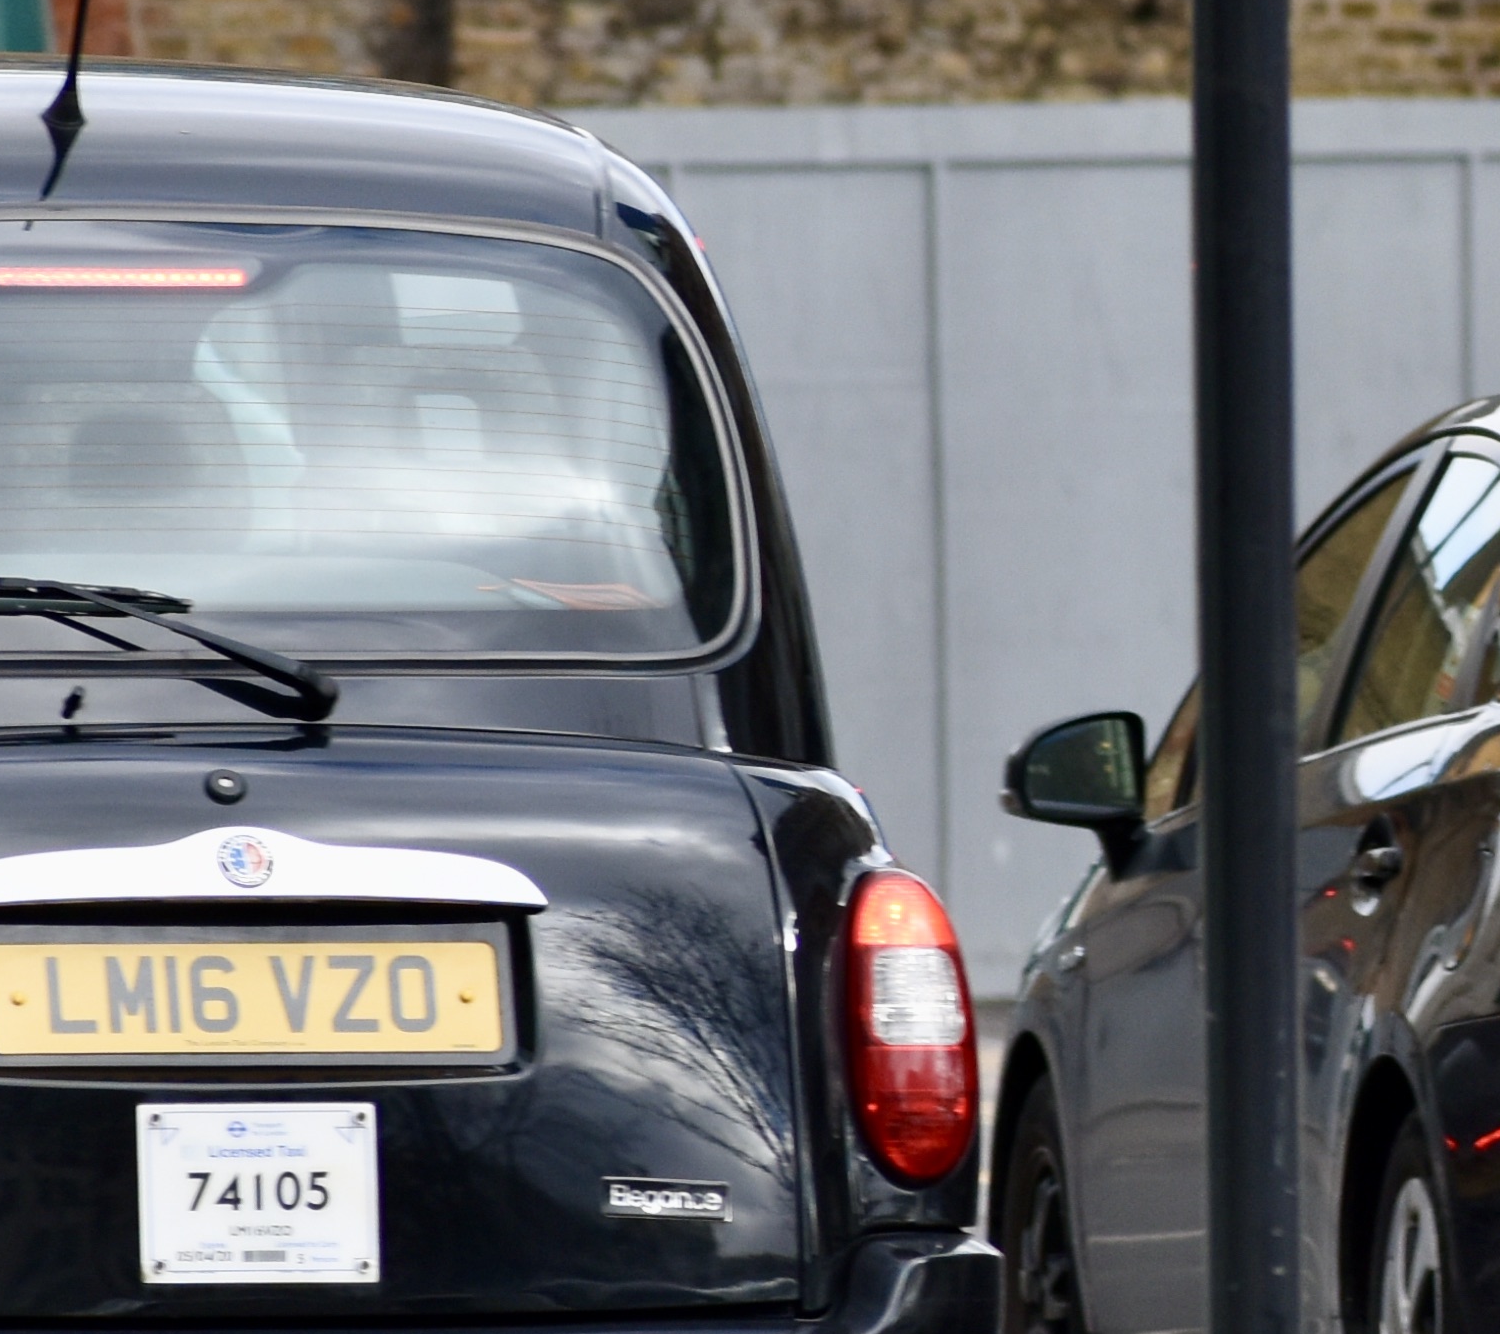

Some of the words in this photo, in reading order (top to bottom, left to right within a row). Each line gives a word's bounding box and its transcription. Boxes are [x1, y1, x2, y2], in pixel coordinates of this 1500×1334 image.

[44, 955, 239, 1034] LM16
[269, 954, 438, 1033] VZO
[207, 1145, 273, 1158] Licensed
[187, 1171, 331, 1212] 74105
